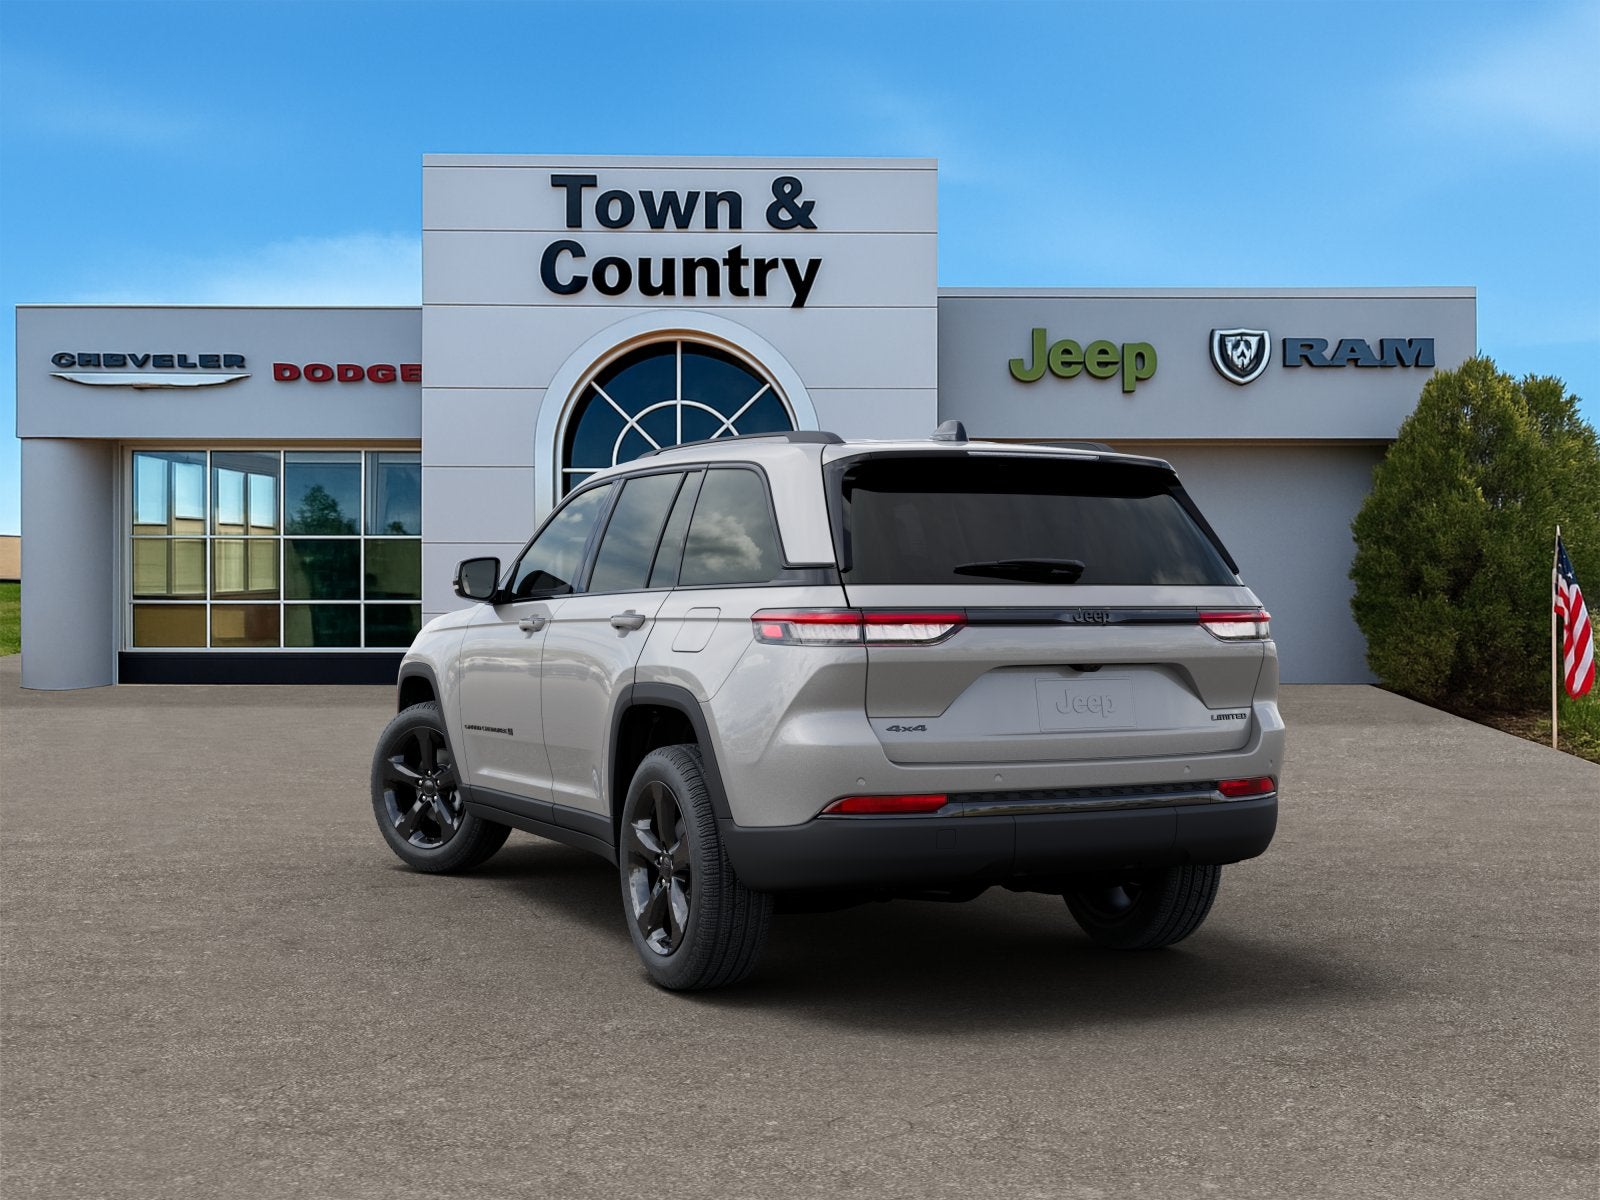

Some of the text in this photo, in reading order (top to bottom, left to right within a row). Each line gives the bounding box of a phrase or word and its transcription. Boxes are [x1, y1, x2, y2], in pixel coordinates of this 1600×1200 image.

[550, 174, 818, 231] Town &
[540, 239, 823, 309] Country
[1009, 328, 1158, 393] Jeep
[1282, 338, 1436, 368] RAM
[272, 362, 422, 384] DODGE
[1071, 608, 1112, 626] Jeep
[1055, 687, 1116, 719] Jeep
